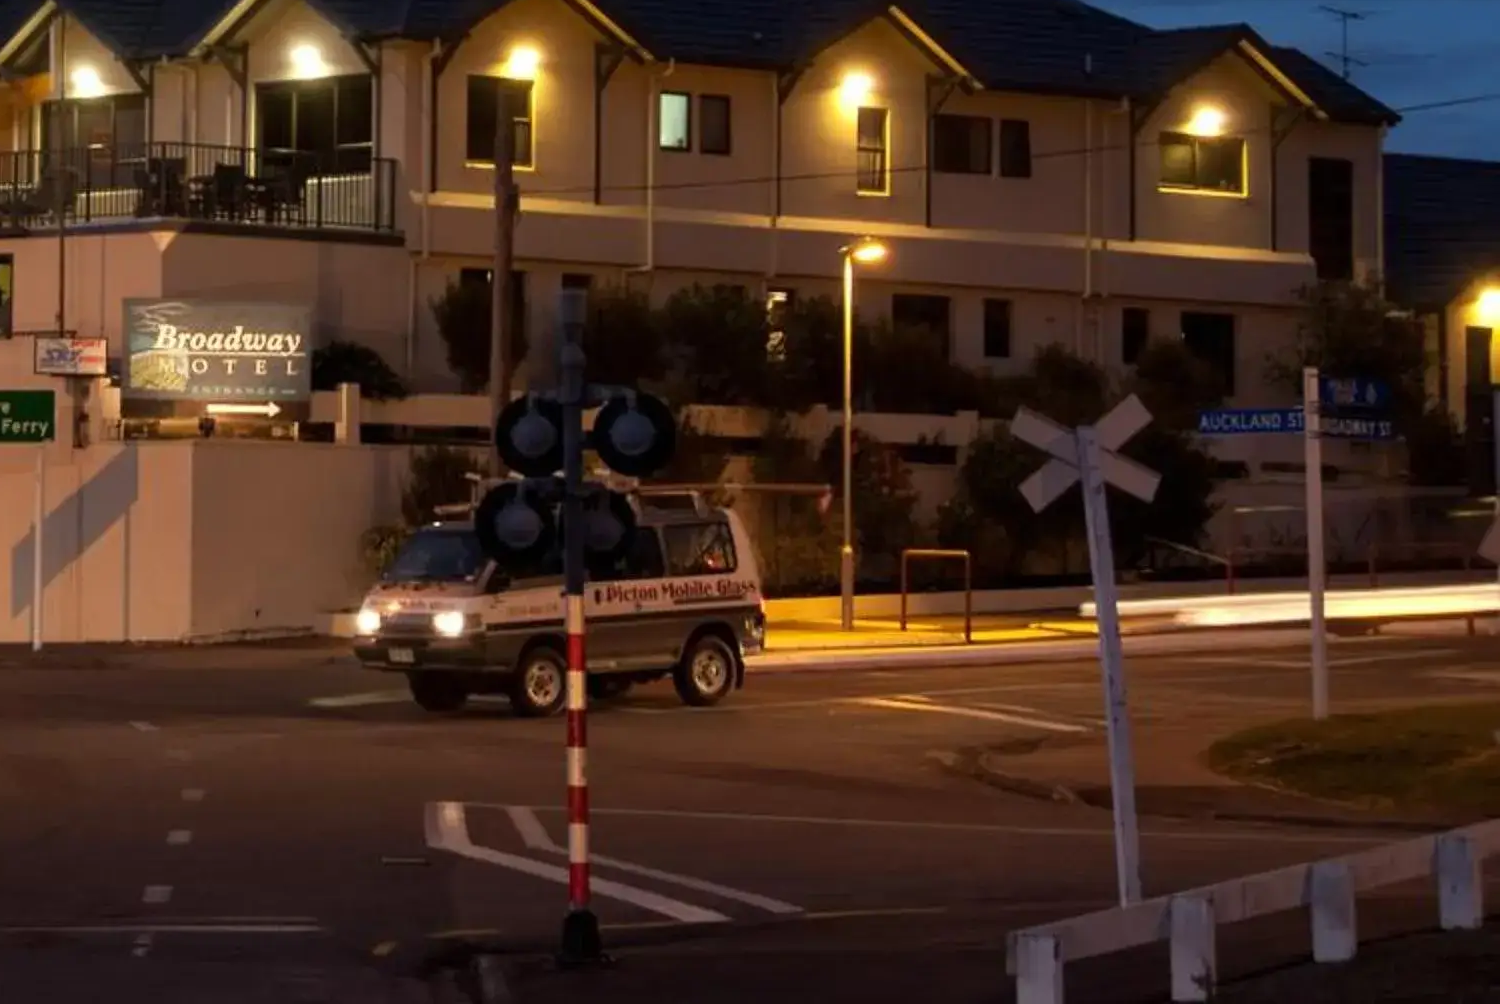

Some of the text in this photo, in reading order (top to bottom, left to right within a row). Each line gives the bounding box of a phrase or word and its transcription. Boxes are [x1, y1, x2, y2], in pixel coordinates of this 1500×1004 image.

[153, 323, 301, 356] Broadway
[157, 358, 298, 376] MOTEL
[1, 418, 49, 437] Ferry
[1200, 414, 1281, 430] AUCKLAND
[606, 578, 757, 604] Picton Mobile Glass
